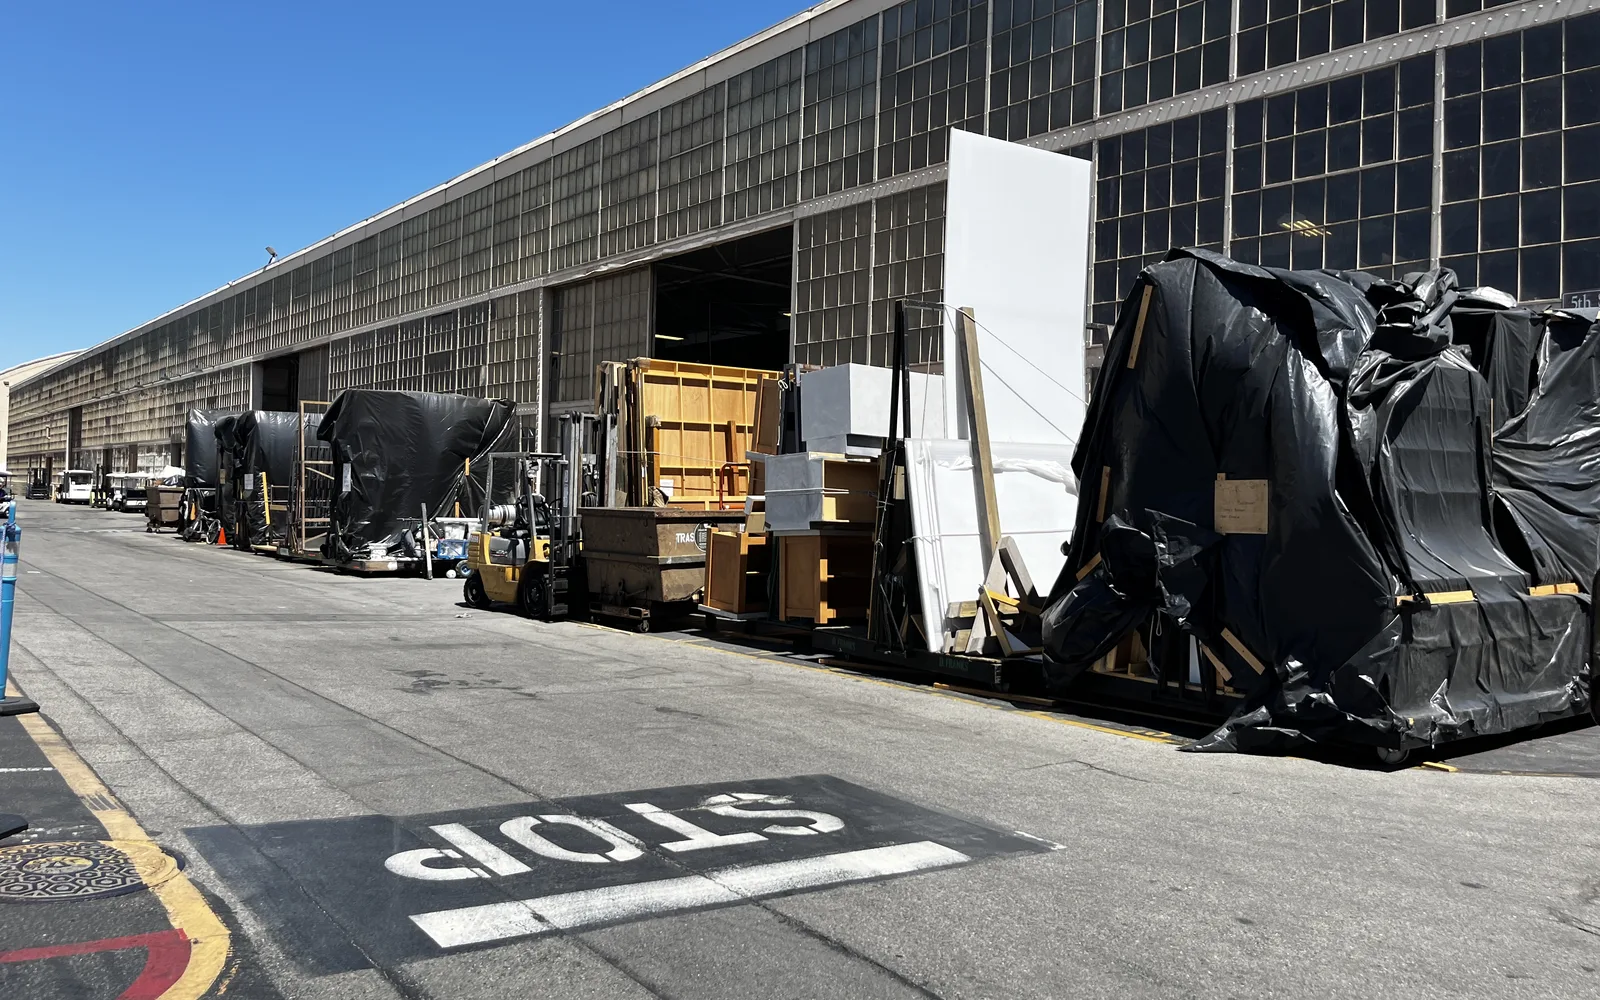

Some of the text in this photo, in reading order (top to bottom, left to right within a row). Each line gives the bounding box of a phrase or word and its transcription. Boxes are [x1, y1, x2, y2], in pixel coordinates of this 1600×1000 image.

[1571, 294, 1591, 308] 5th
[675, 532, 696, 543] TRAS
[384, 792, 845, 881] STOP
